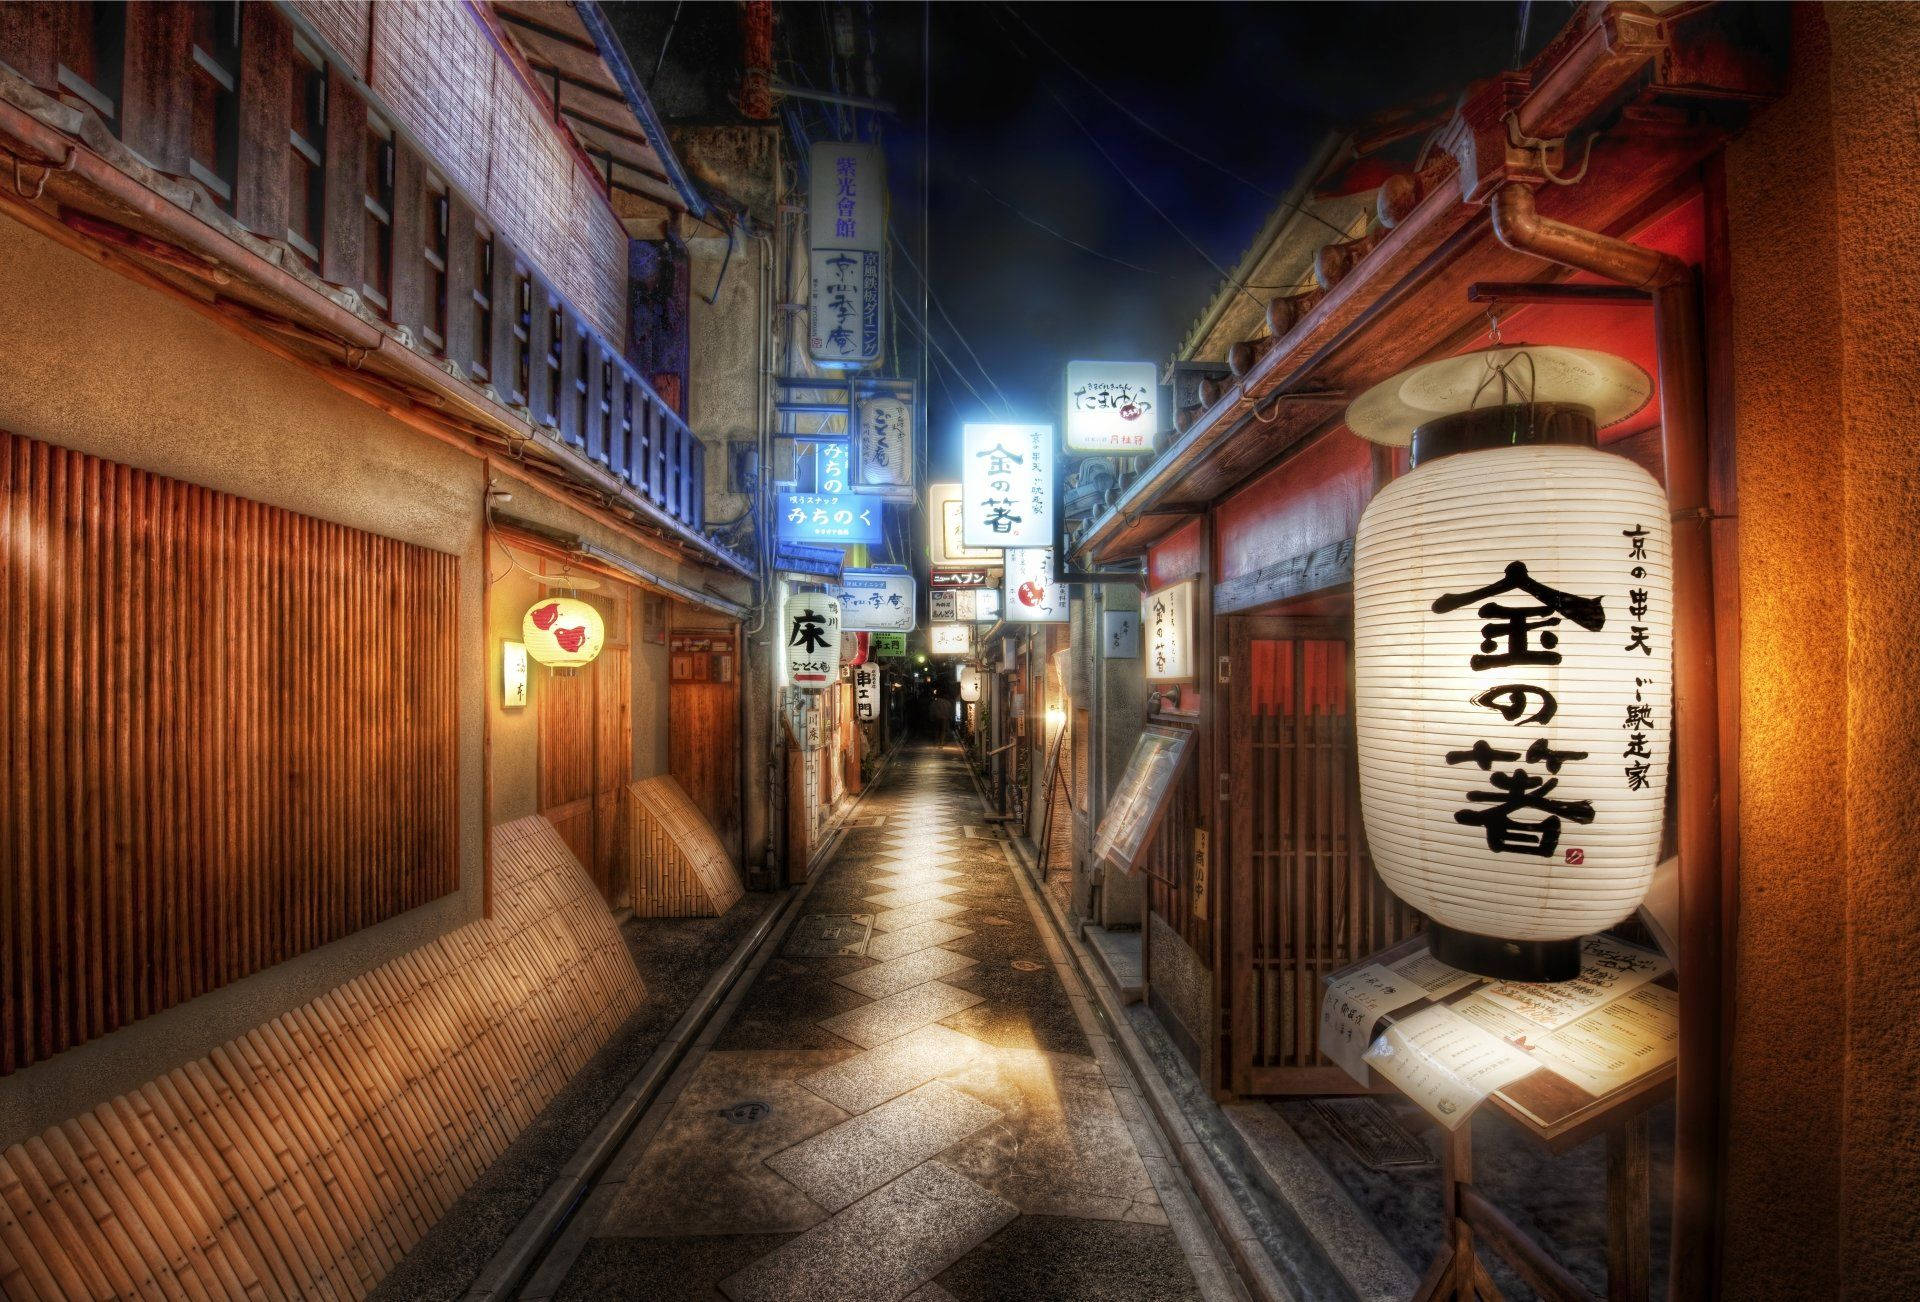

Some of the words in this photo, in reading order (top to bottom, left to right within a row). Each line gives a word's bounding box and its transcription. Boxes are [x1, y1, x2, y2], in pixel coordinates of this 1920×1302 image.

[836, 157, 856, 238] 紫光會館
[788, 507, 871, 526] みちのく
[788, 608, 833, 654] 床
